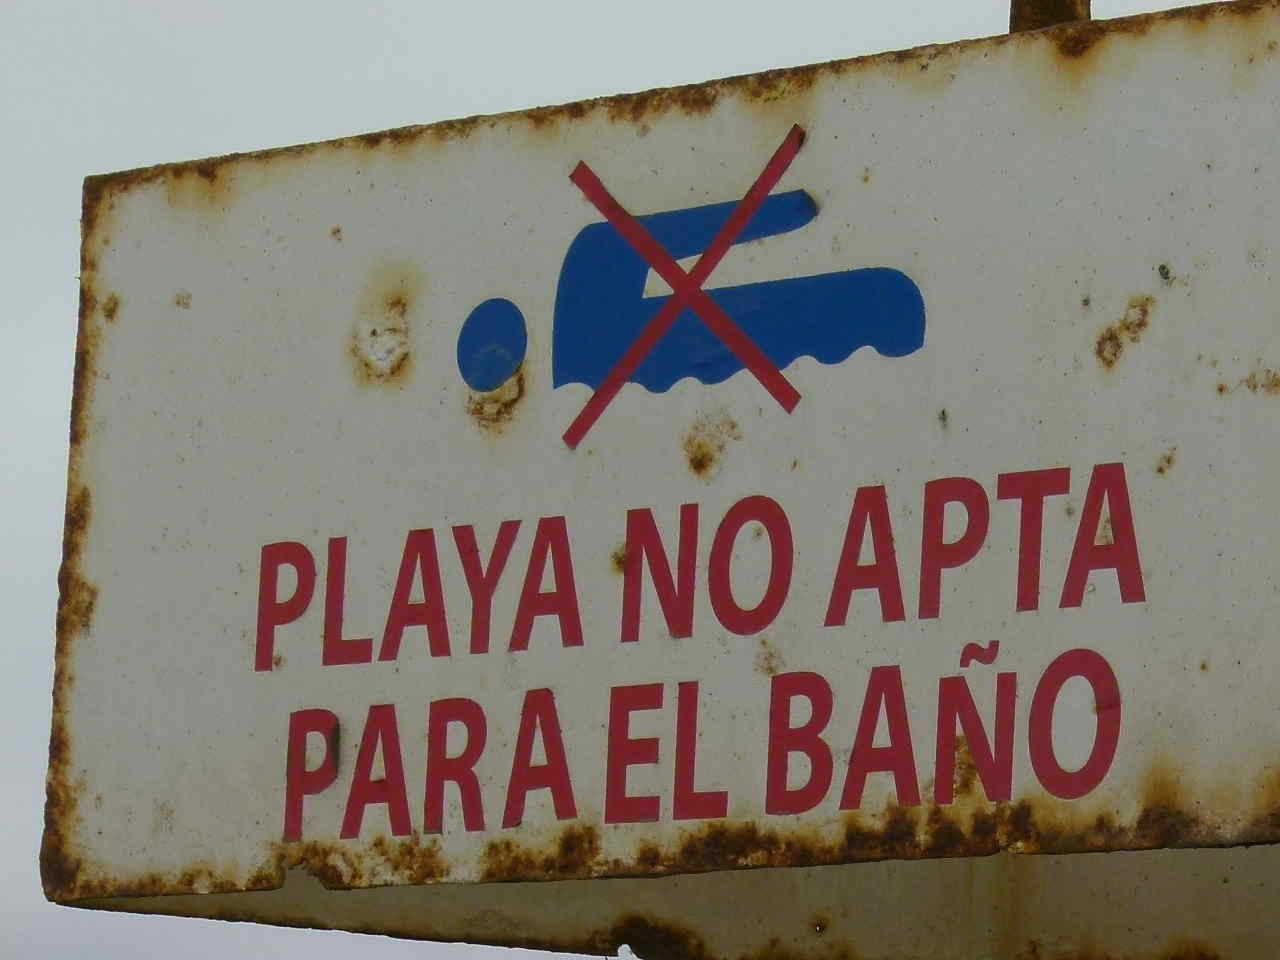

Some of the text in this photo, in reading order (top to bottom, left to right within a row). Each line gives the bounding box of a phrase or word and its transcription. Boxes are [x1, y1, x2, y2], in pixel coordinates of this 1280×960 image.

[254, 462, 1147, 673] PLAYA NO APTA
[282, 639, 1123, 843] PARA EL BAÑO
